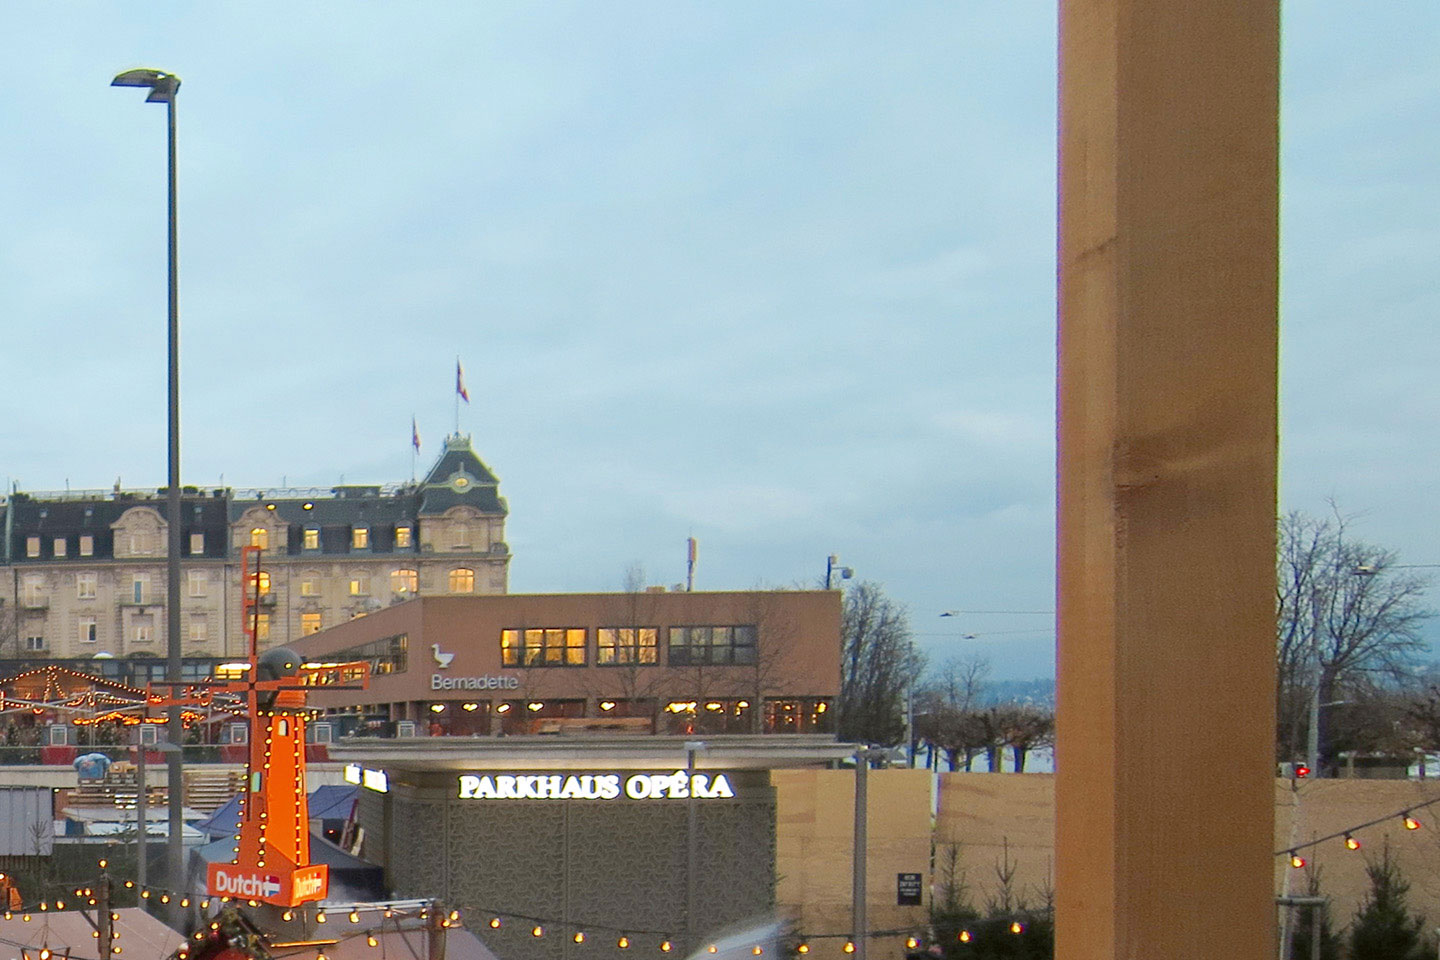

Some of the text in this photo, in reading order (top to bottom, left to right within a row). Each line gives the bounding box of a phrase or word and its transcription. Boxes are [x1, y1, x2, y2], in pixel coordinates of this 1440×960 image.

[431, 672, 519, 691] Bernadette
[458, 769, 735, 800] PARKHAUS OPÉRA
